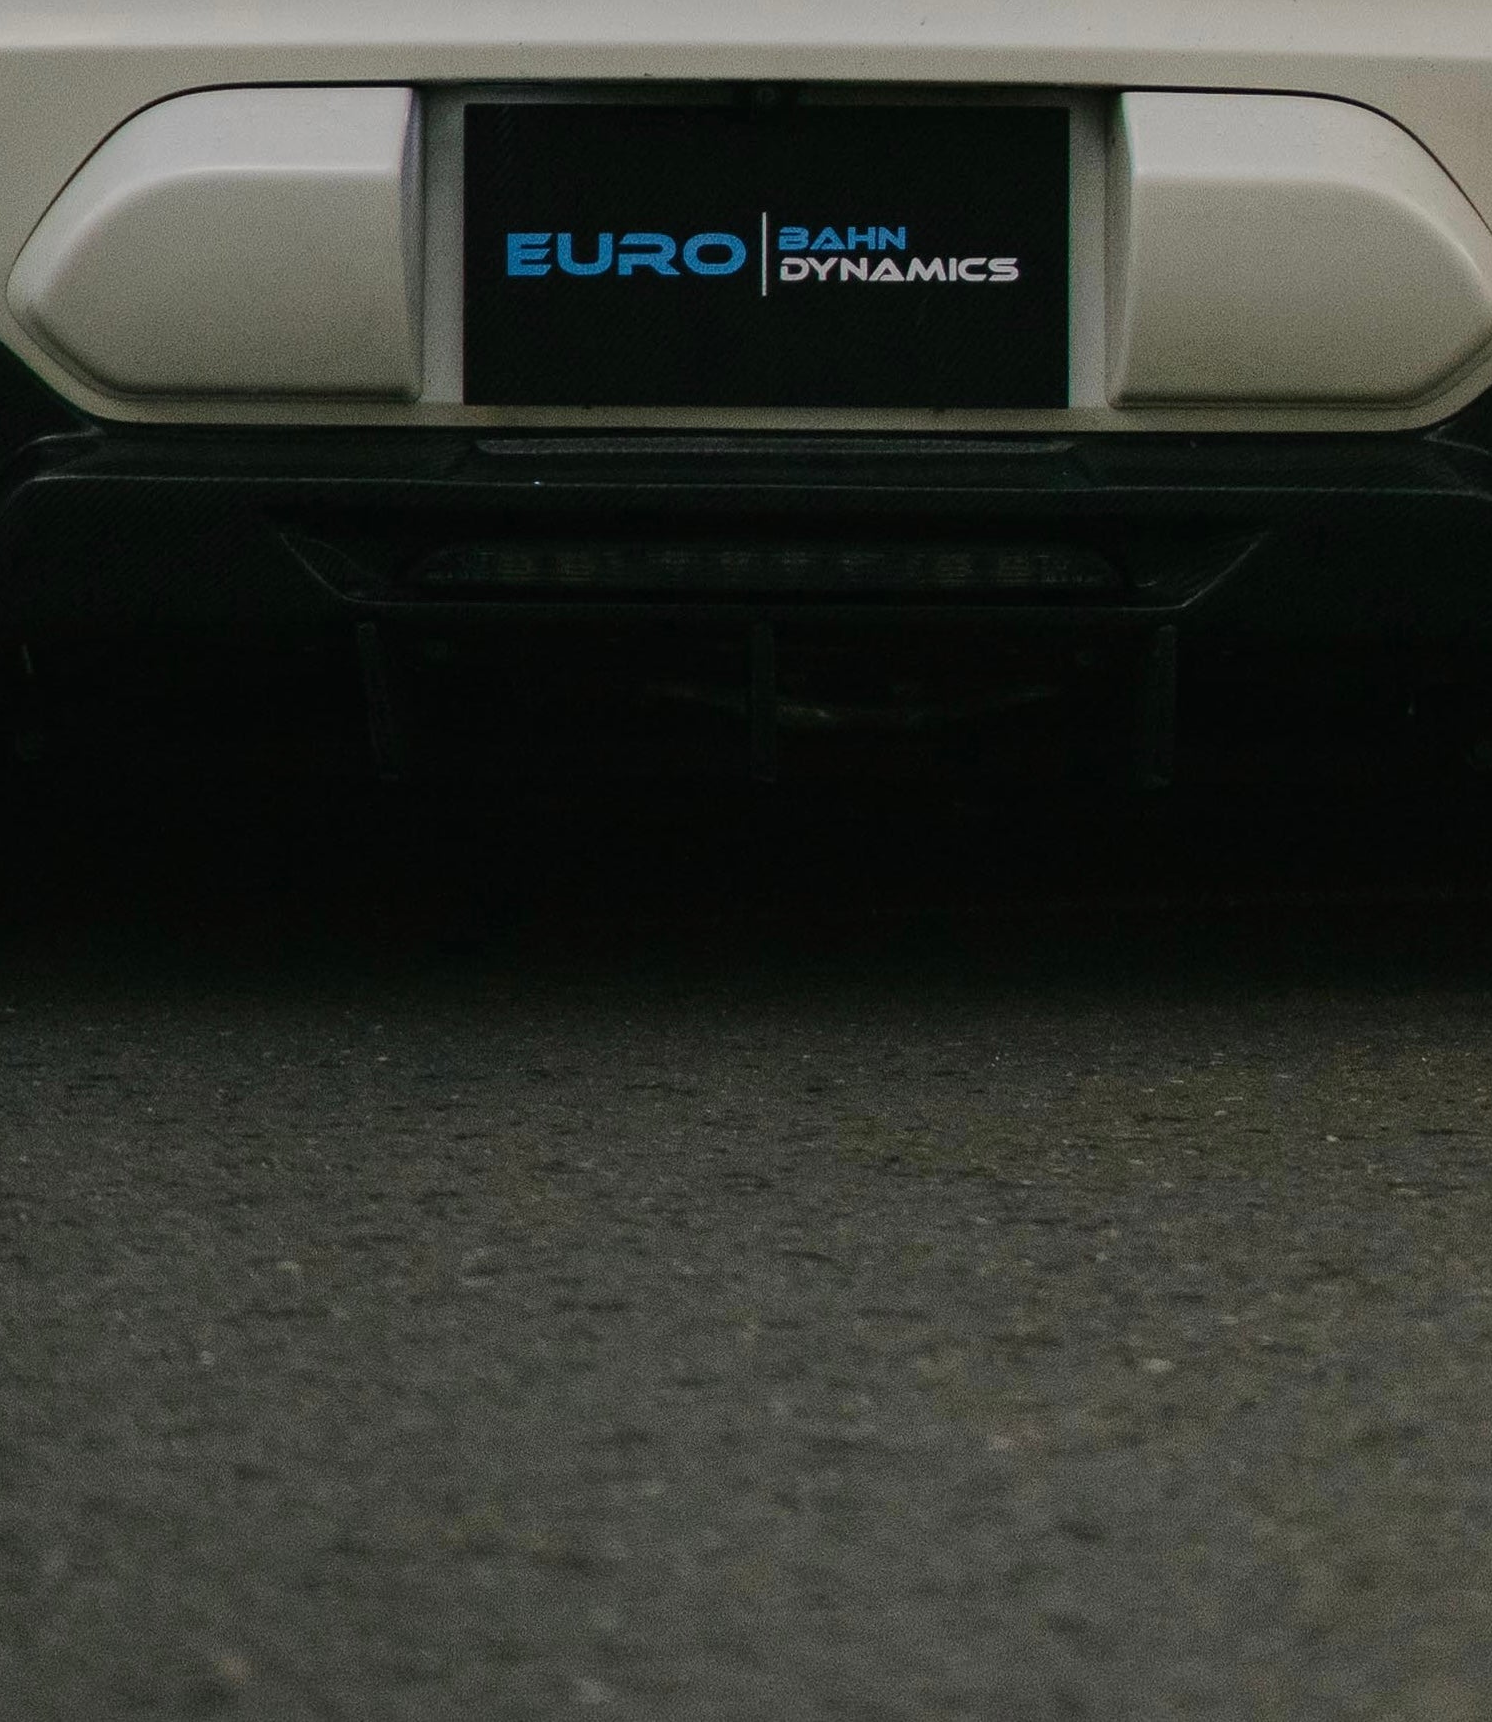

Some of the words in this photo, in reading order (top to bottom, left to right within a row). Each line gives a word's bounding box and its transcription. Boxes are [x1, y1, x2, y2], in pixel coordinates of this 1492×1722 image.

[777, 225, 908, 252] BAHN
[506, 232, 747, 277] EURO
[779, 256, 1020, 283] DYNAMICS
